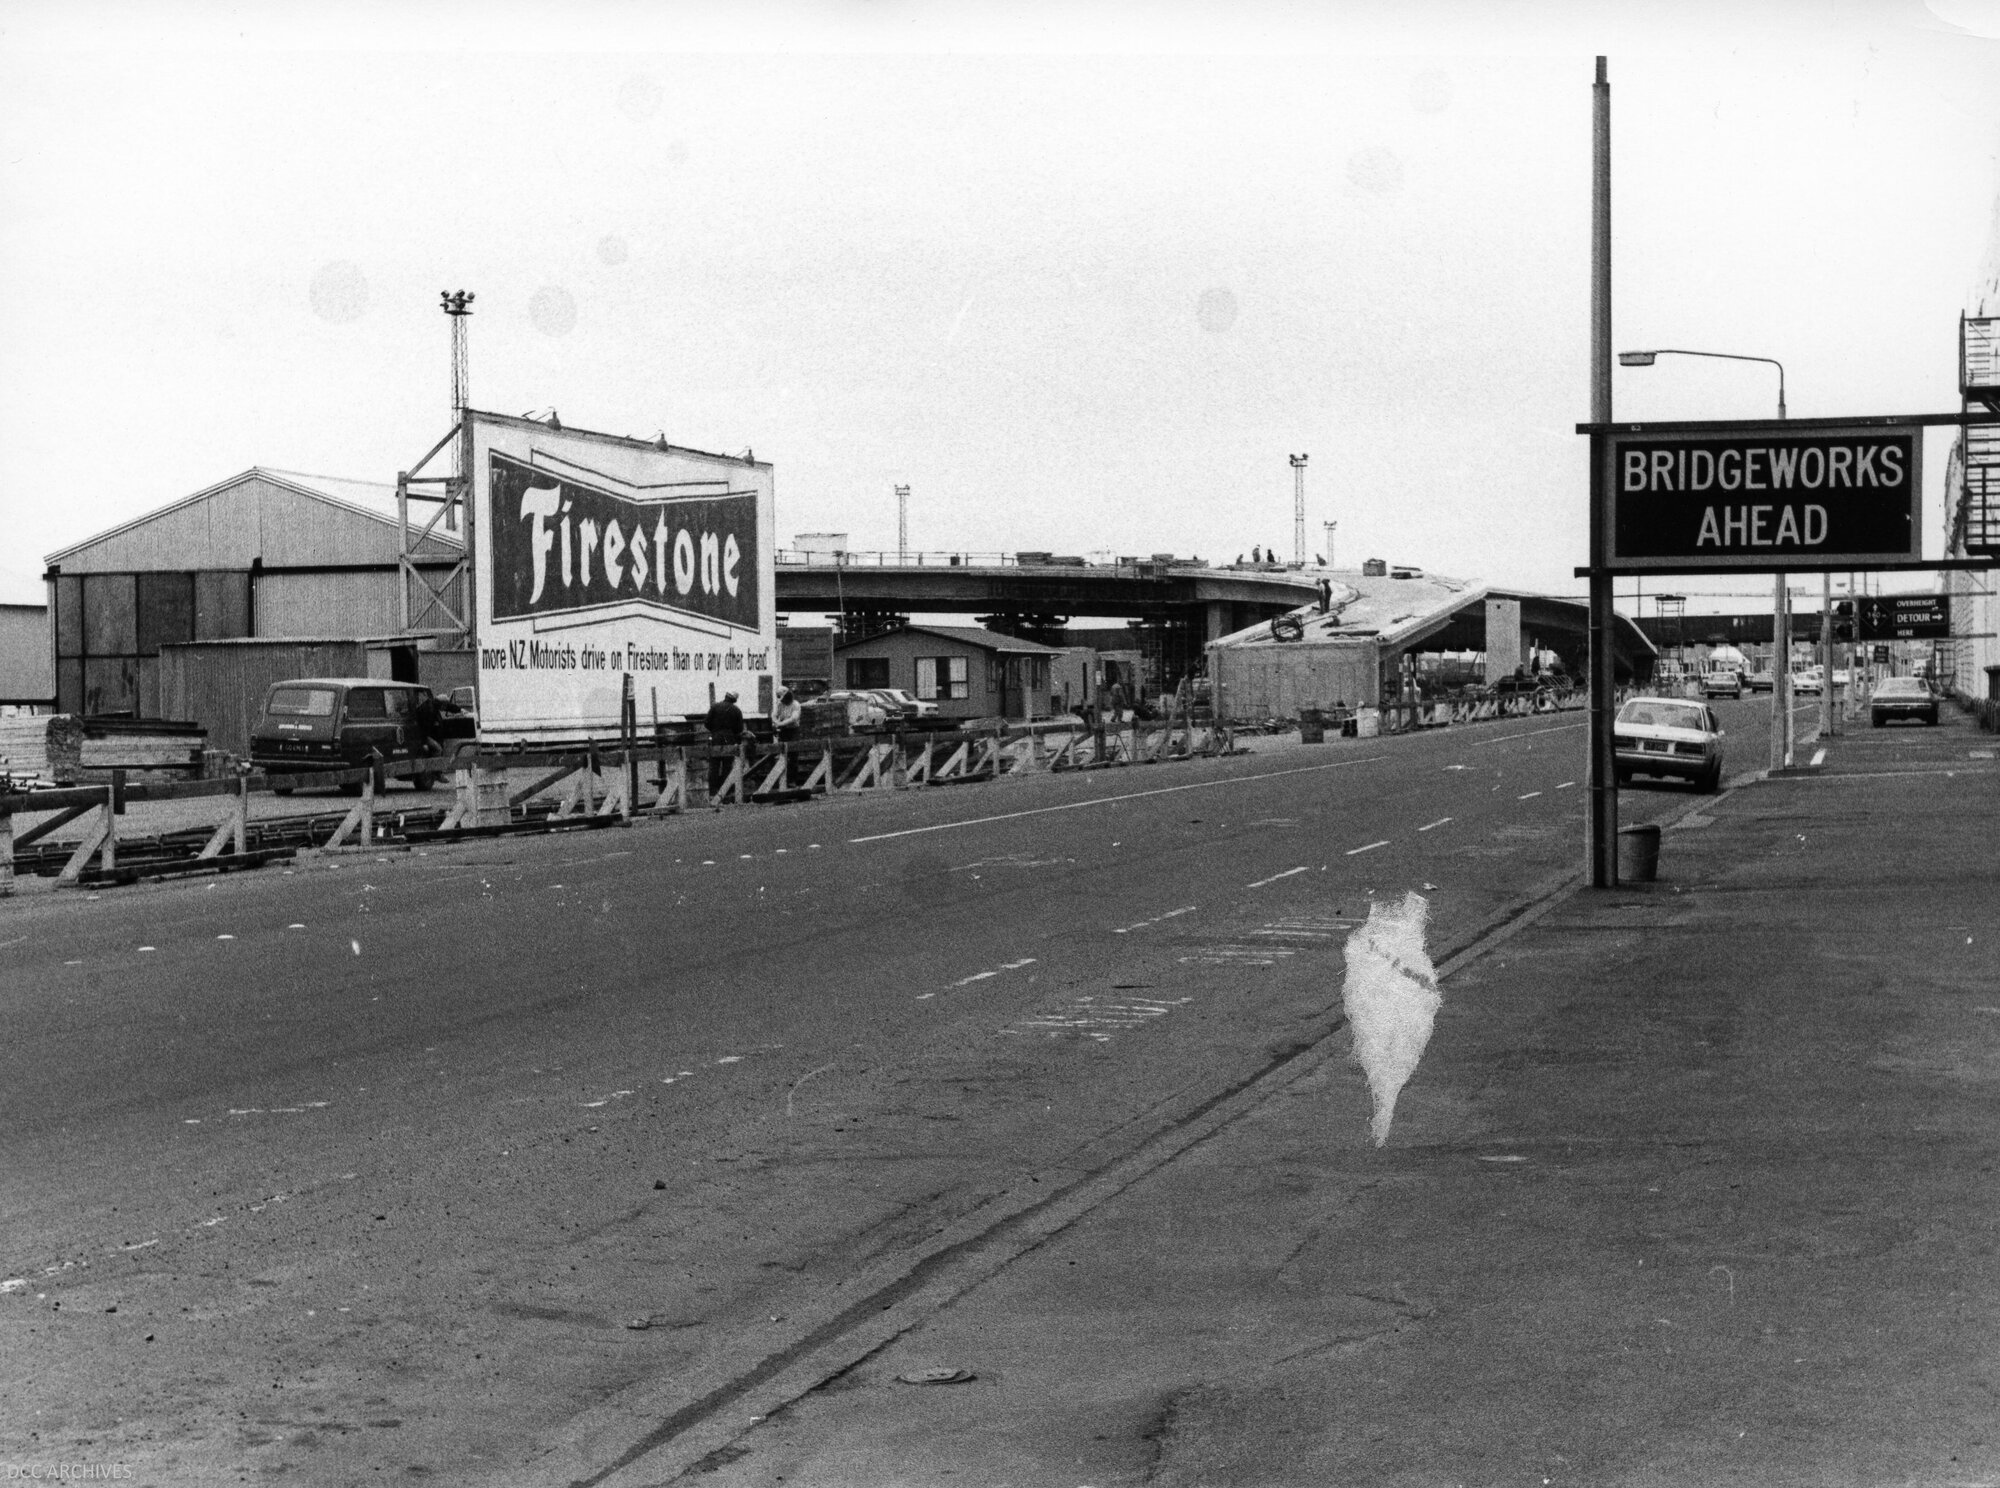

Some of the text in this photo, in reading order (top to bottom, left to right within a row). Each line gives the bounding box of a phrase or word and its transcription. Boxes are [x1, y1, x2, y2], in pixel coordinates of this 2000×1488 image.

[1624, 445, 1904, 492] BRIDGEWORKS
[520, 484, 741, 605] Firestone
[1696, 504, 1828, 547] AHEAD
[1896, 599, 1937, 608] OVERHEIGHT
[1897, 613, 1931, 623] DETOUR
[1897, 629, 1914, 637] HERE
[509, 639, 528, 671] N.Z.
[529, 639, 577, 670] Motorists
[581, 643, 606, 670] drive
[611, 650, 623, 670] on
[627, 642, 669, 671] Firestone
[673, 646, 691, 671] than
[694, 652, 704, 671] on
[707, 652, 721, 677] any
[725, 646, 743, 671] other
